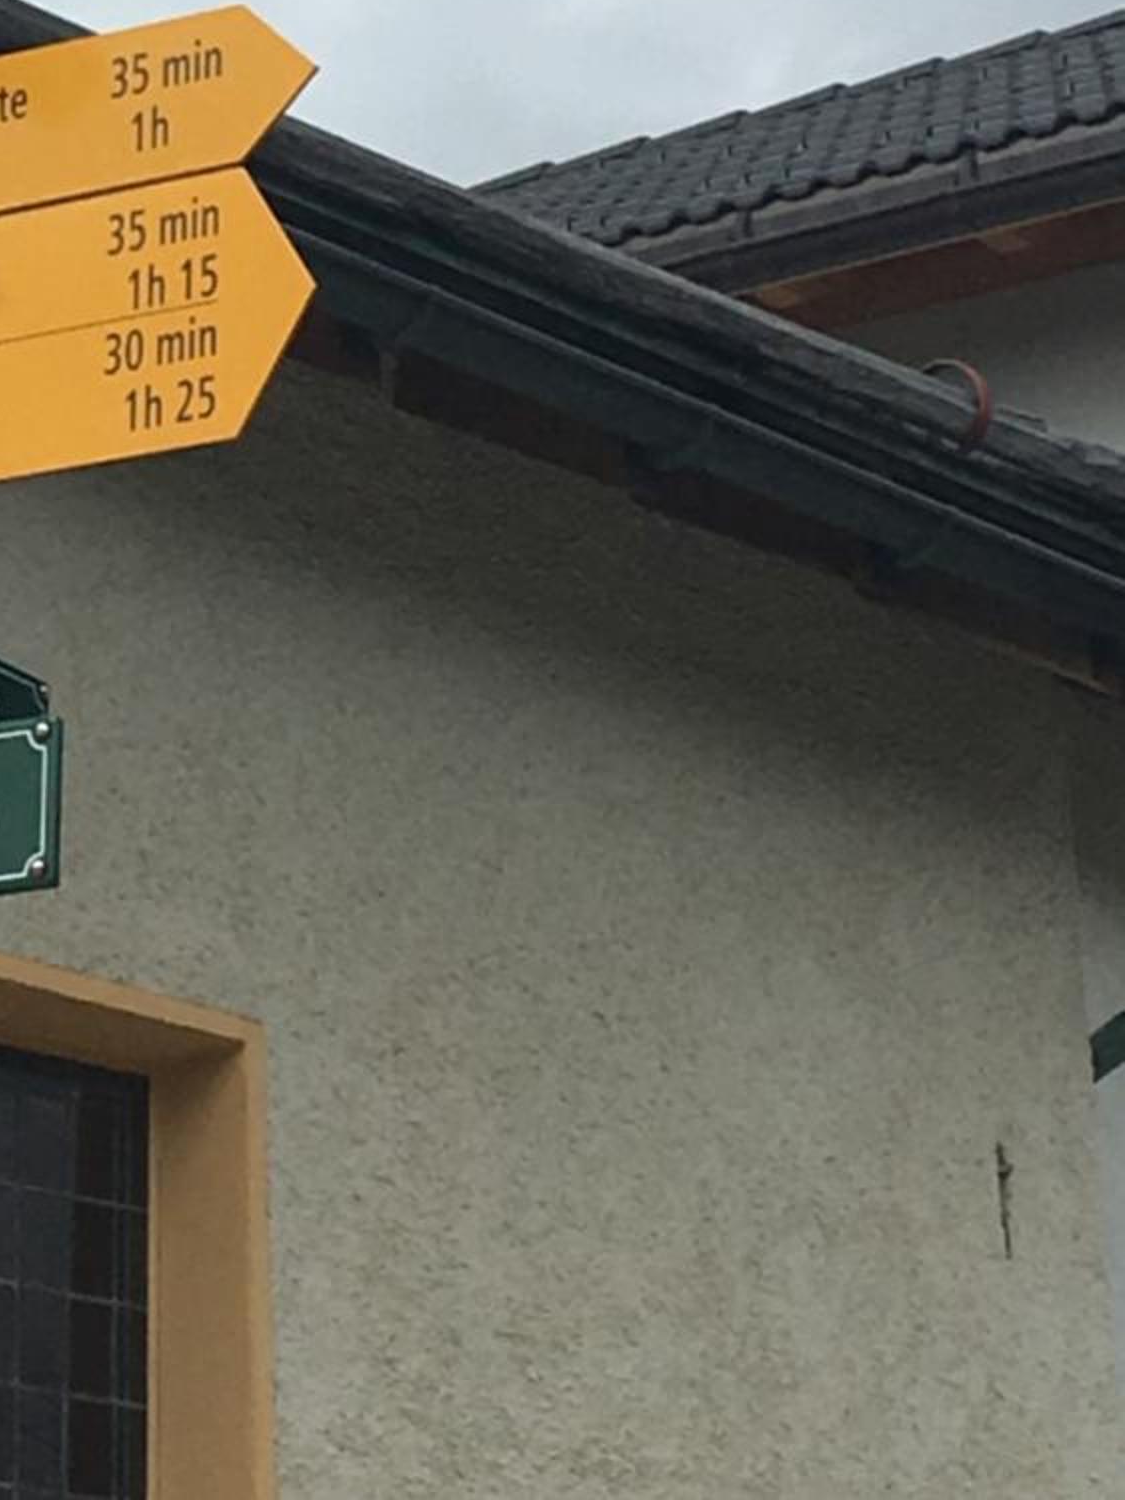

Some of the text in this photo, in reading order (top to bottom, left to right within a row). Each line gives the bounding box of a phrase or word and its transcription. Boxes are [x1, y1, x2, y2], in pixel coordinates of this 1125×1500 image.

[111, 57, 149, 99] 35
[161, 42, 223, 88] min
[132, 108, 169, 152] 1h
[107, 212, 146, 255] 35
[160, 199, 220, 244] min
[128, 268, 166, 309] 1h
[181, 255, 218, 299] 15
[105, 330, 145, 375] 30
[156, 318, 216, 364] min
[126, 388, 162, 431] 1h
[177, 375, 215, 422] 25
